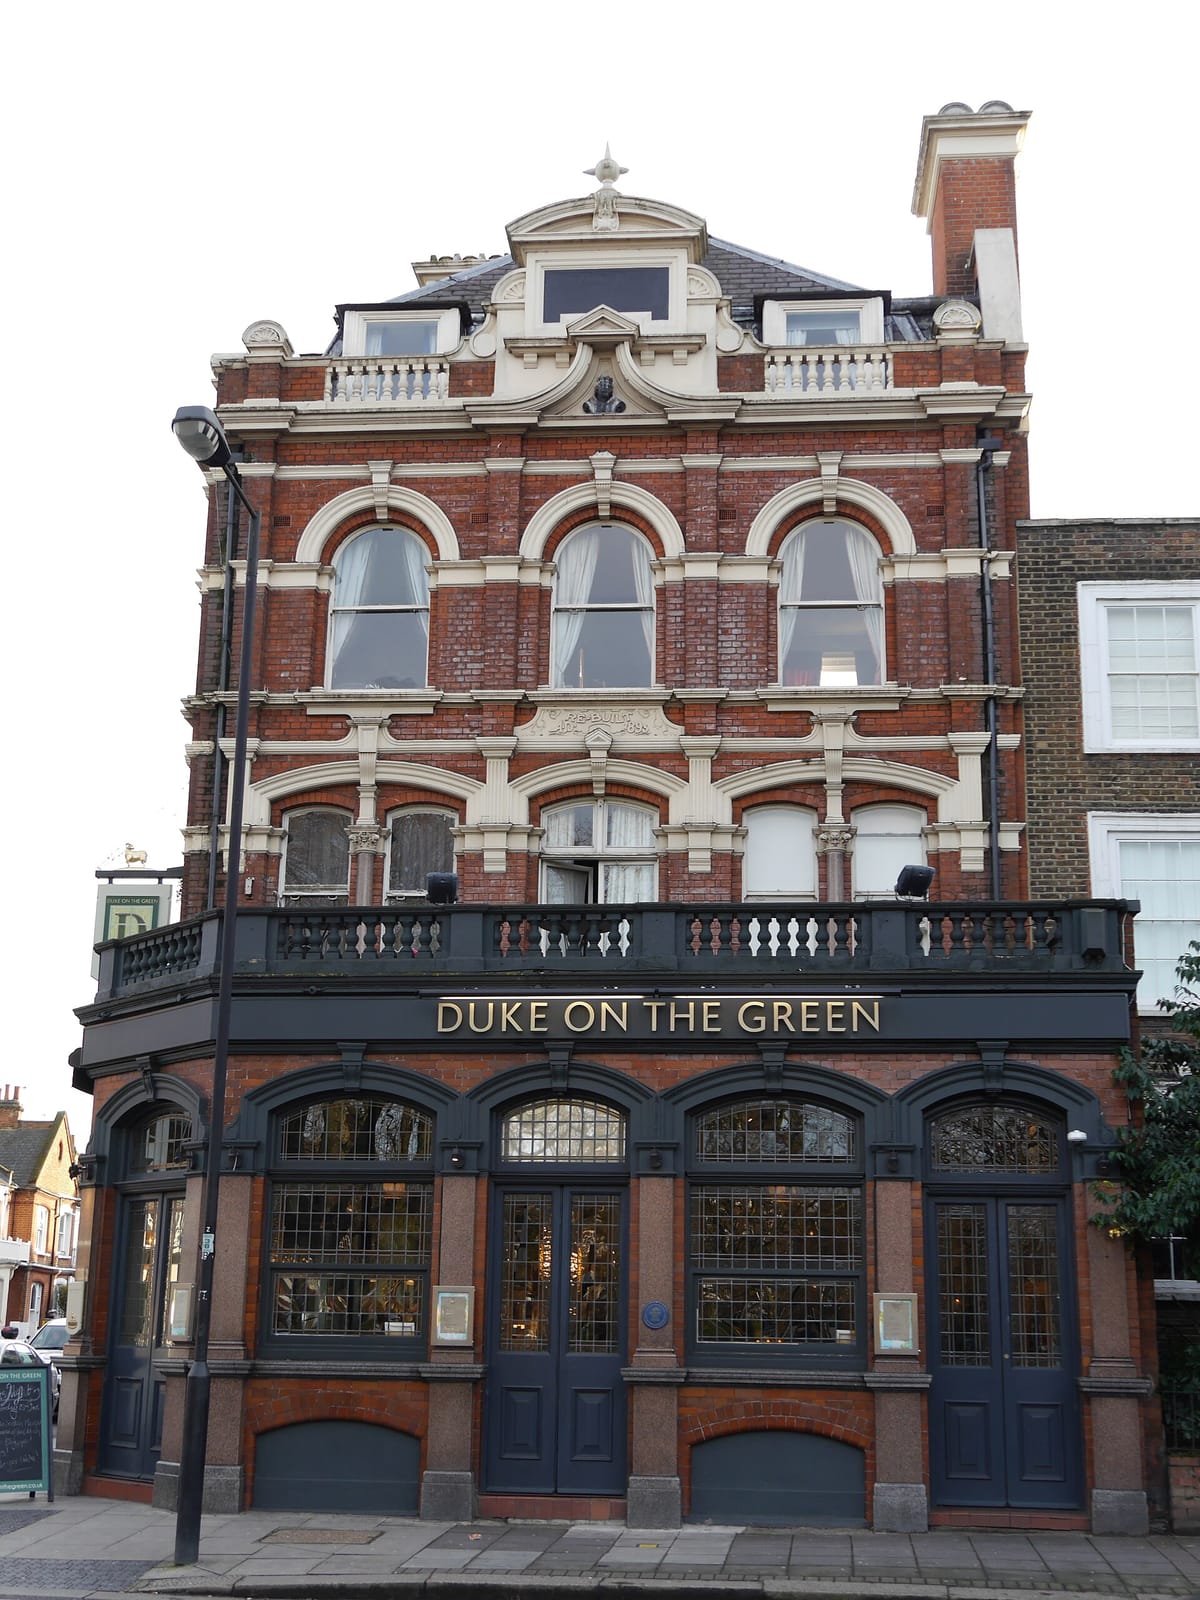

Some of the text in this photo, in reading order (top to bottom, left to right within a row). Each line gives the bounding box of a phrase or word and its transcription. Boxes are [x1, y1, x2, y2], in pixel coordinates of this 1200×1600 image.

[437, 1001, 880, 1033] DUKE ON THE GREEN
